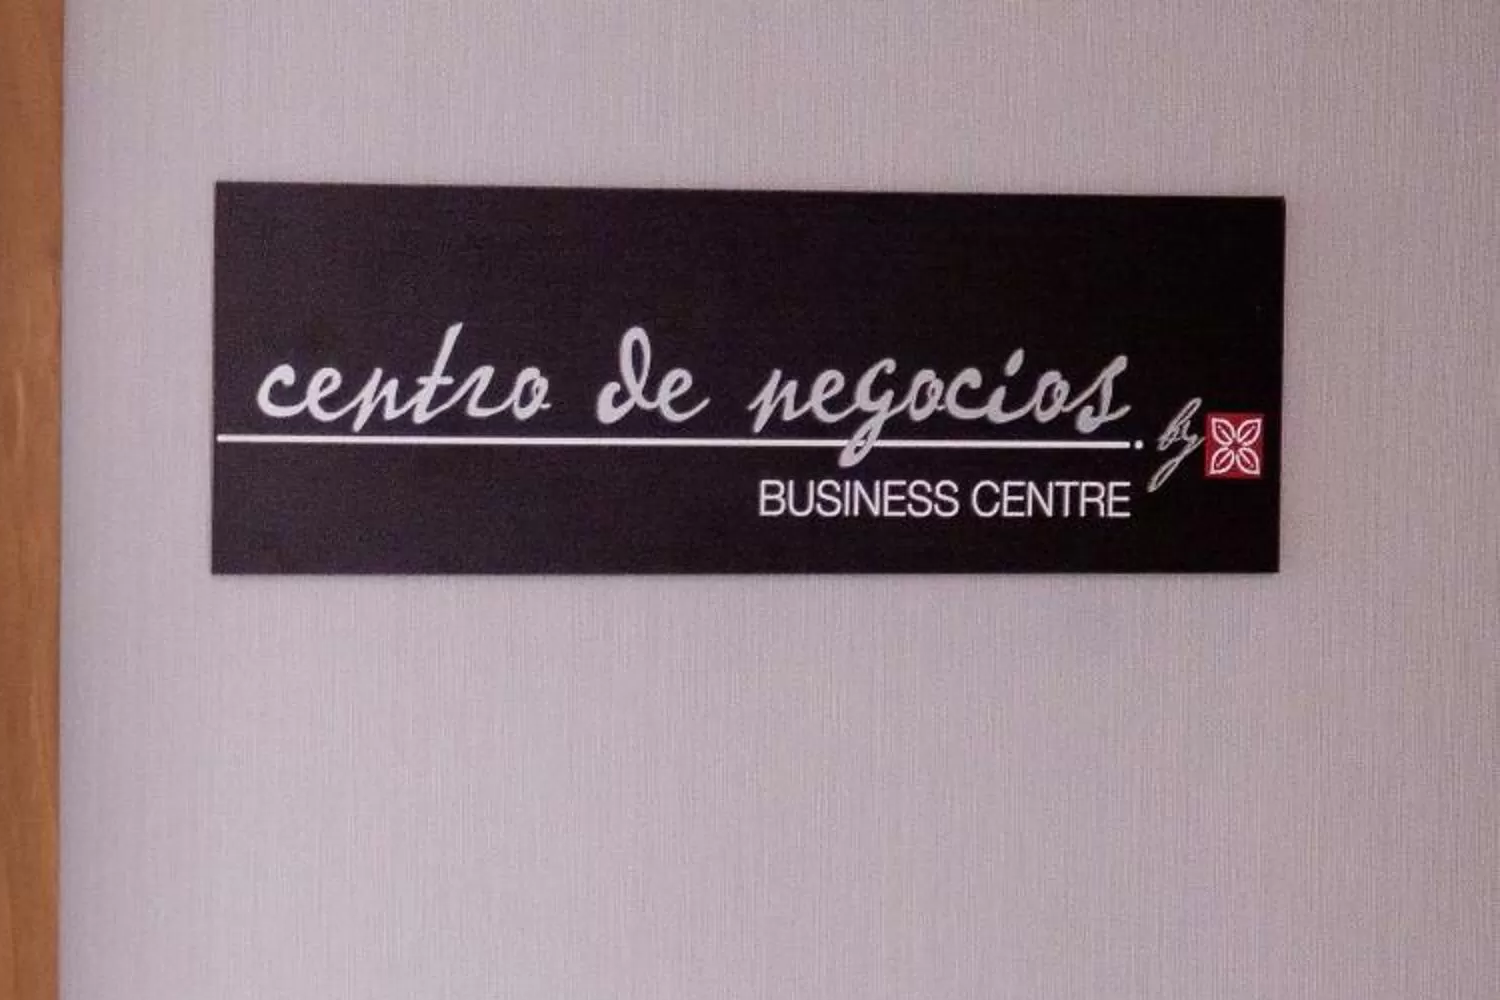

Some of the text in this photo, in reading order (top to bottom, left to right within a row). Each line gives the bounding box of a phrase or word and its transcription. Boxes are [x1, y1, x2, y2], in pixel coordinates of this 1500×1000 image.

[596, 325, 710, 425] de
[1146, 397, 1206, 493] by
[758, 479, 1131, 519] BUSINESS CENTRE
